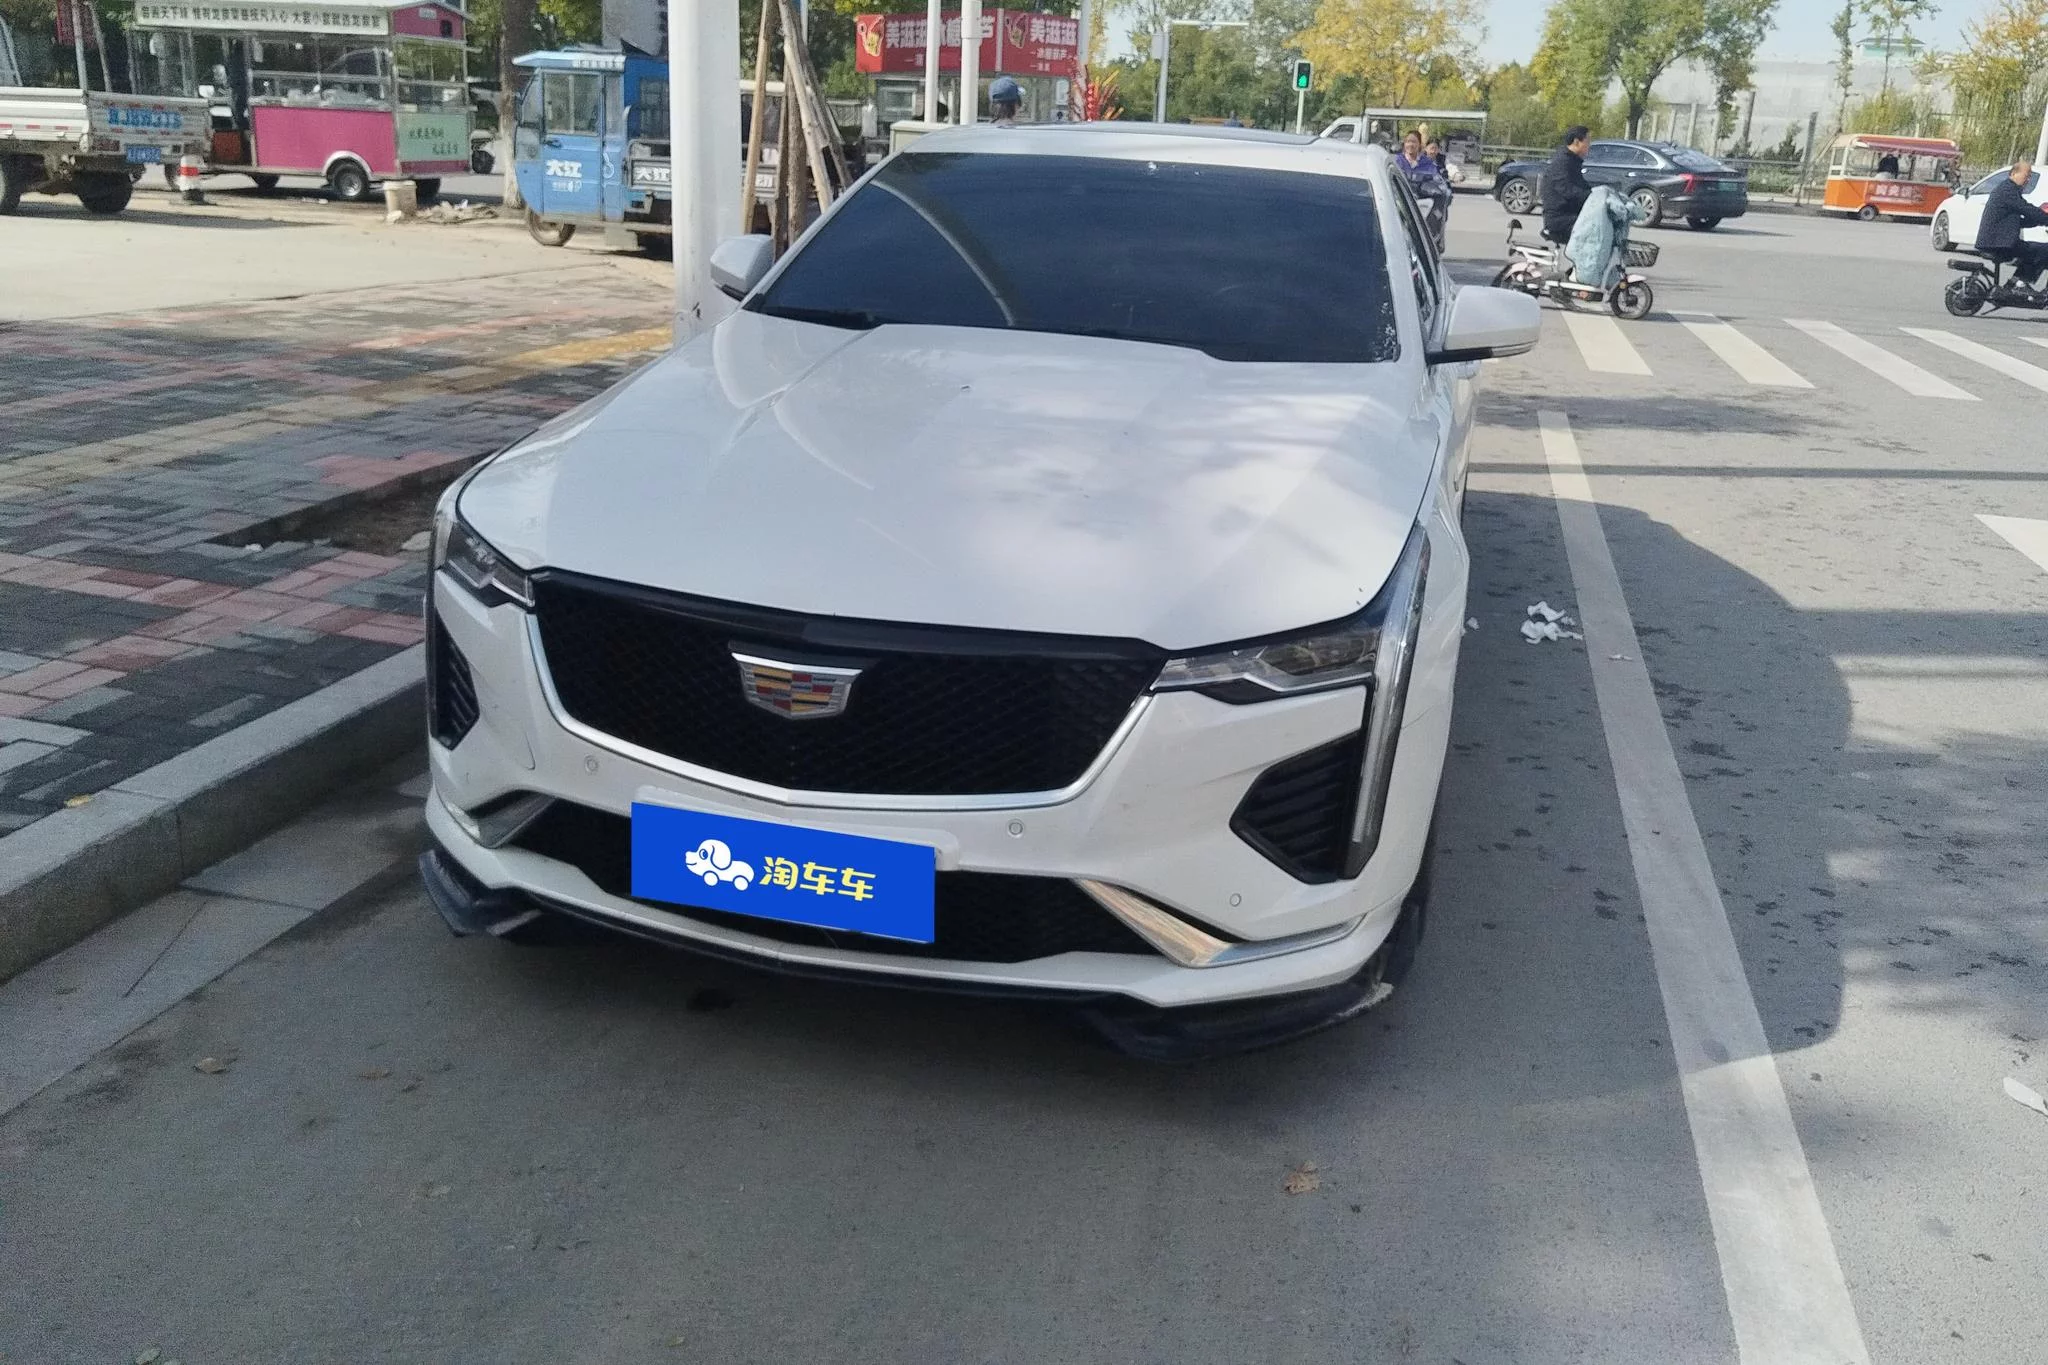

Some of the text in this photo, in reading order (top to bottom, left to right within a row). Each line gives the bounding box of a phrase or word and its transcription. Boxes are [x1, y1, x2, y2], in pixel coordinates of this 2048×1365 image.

[1030, 17, 1077, 47] 美滋滋
[546, 159, 583, 178] 大江
[635, 167, 670, 182] 大江
